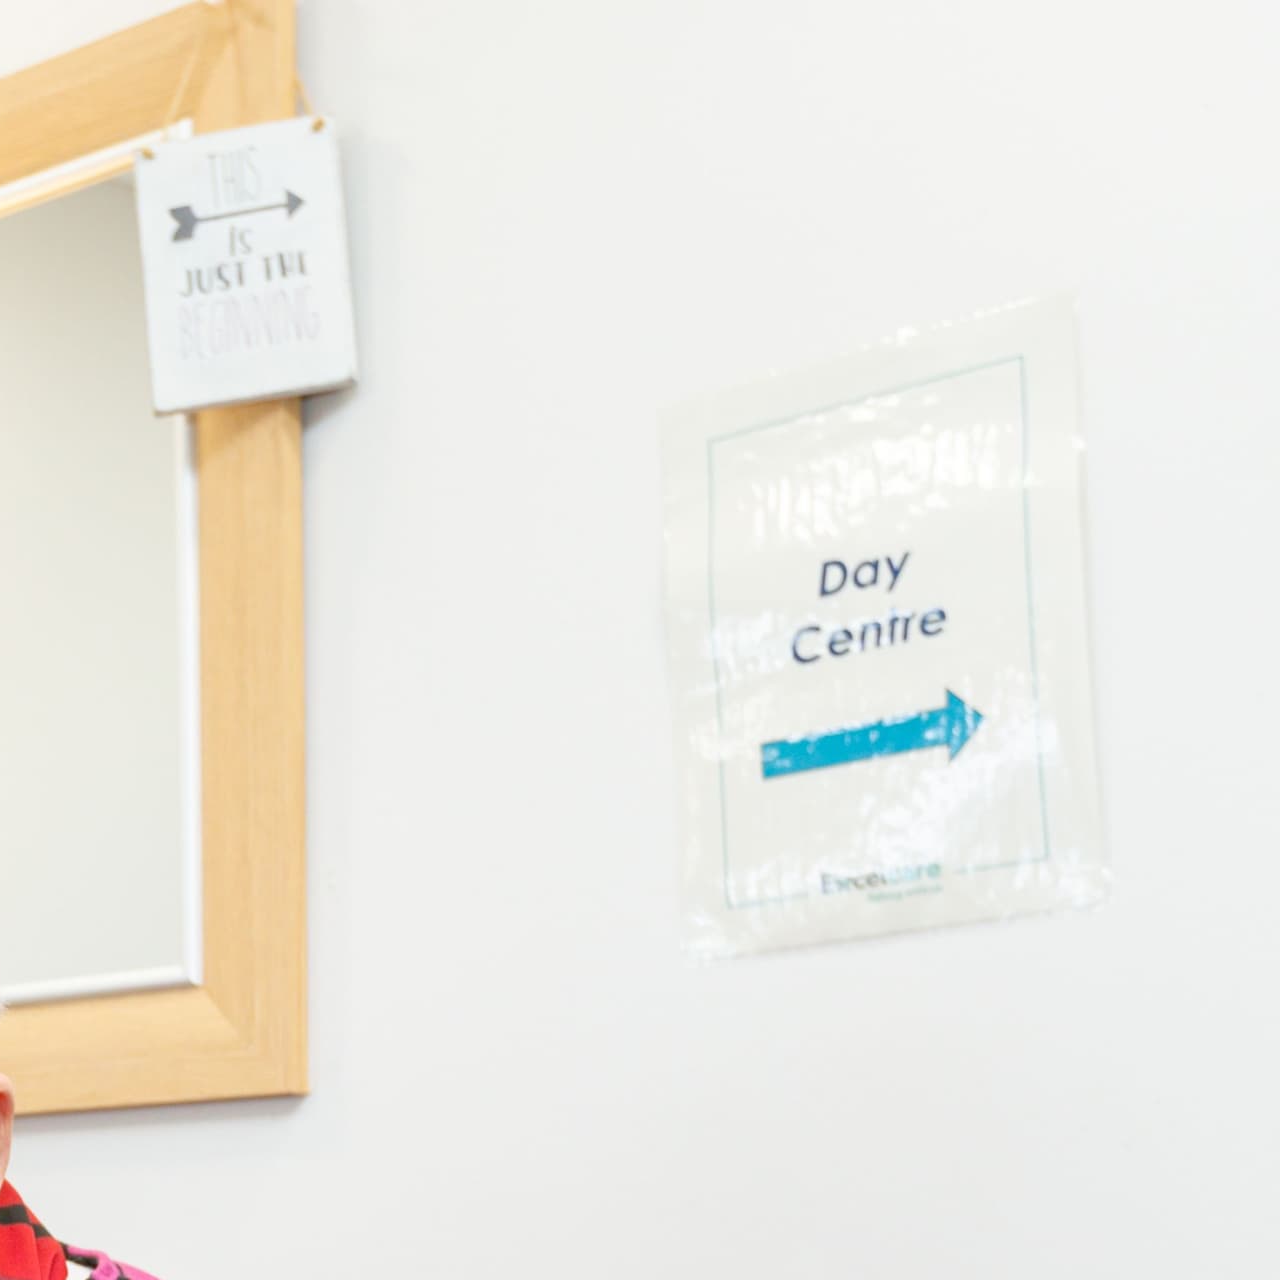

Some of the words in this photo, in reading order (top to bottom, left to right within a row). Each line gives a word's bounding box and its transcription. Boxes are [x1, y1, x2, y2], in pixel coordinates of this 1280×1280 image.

[207, 144, 262, 209] THIS
[179, 258, 249, 297] JUST
[262, 250, 309, 283] THE
[176, 287, 321, 361] BEGINNING
[818, 548, 913, 599] Day
[790, 604, 950, 667] Centre
